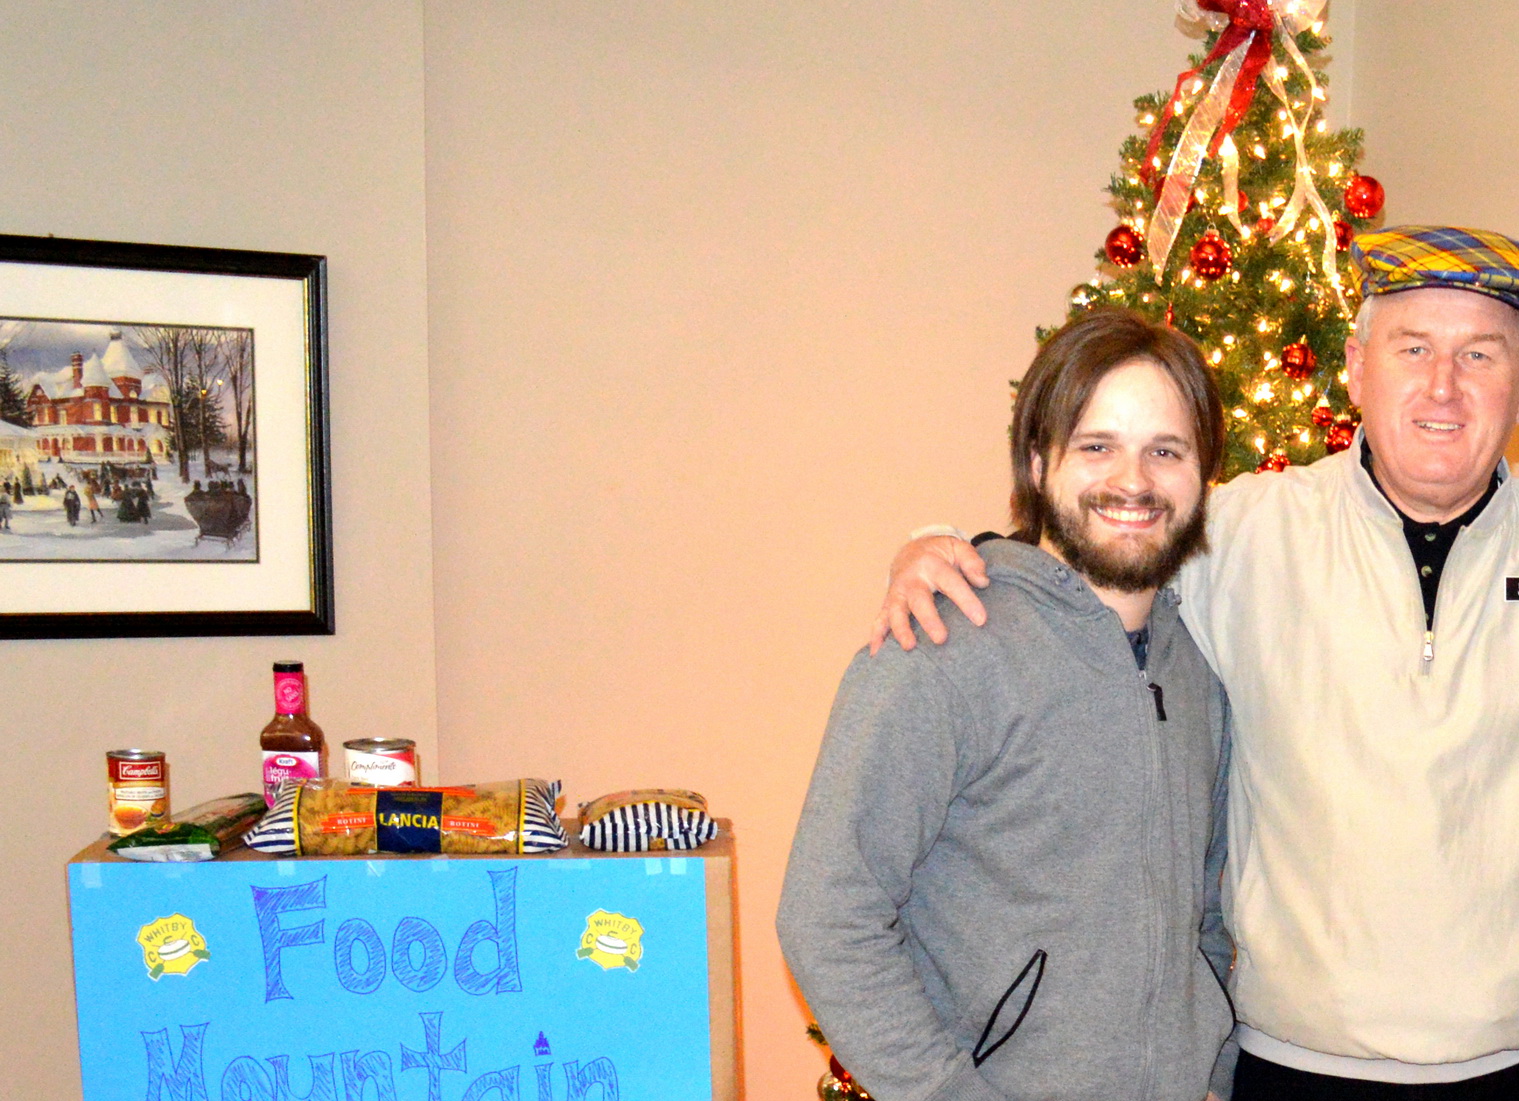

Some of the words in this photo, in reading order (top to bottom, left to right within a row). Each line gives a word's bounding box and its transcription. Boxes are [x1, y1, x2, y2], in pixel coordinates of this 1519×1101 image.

[278, 757, 296, 767] Kraft
[351, 760, 398, 774] Compliments
[120, 764, 160, 777] Campbell's
[336, 816, 367, 826] ROTINI
[378, 812, 441, 830] LANCIA
[449, 820, 480, 829] ROTINI
[592, 916, 639, 938] WHITBY
[143, 920, 189, 949] WHITBY
[248, 865, 524, 1004] Food
